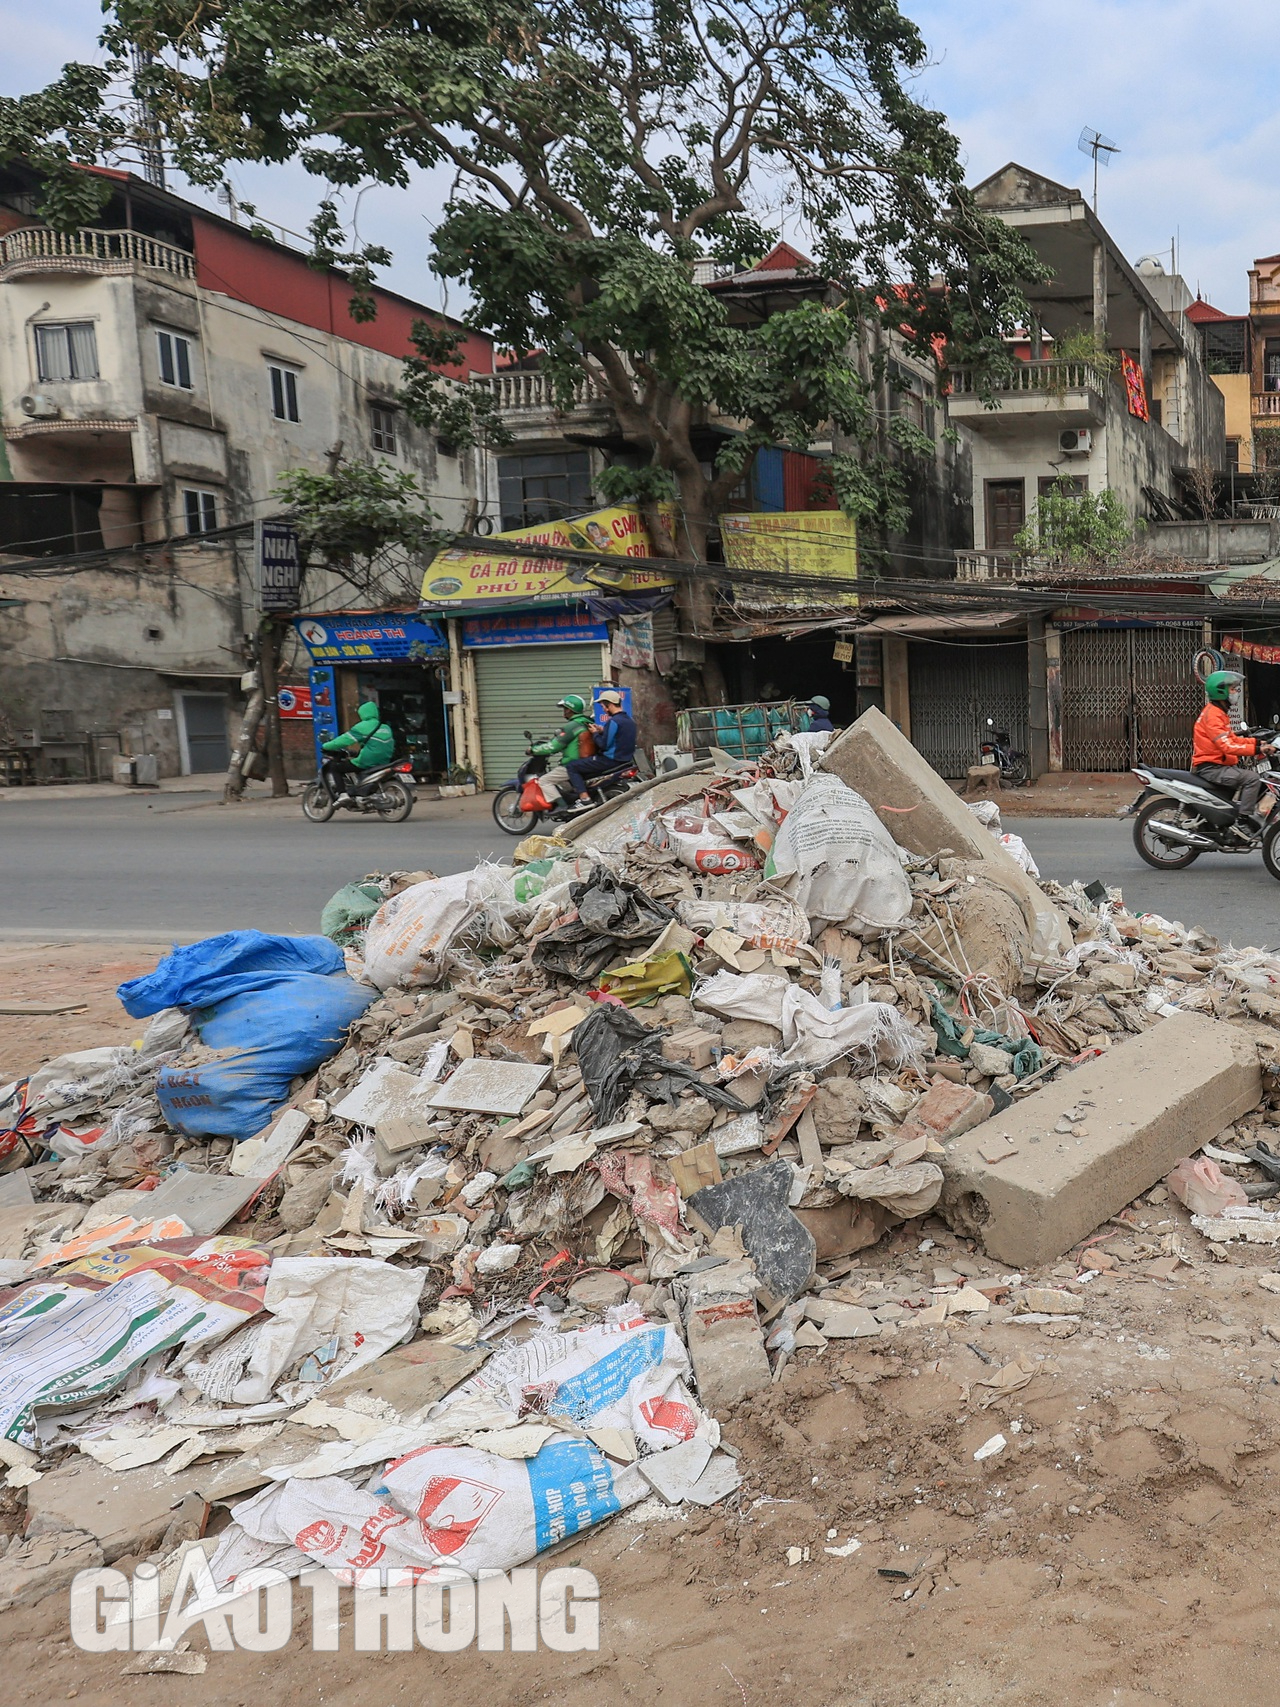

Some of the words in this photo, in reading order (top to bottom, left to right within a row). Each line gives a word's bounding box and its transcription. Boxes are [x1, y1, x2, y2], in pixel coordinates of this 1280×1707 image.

[264, 534, 297, 559] NHÀ
[334, 628, 383, 641] HOÀNG
[167, 1071, 204, 1089] BIỆT
